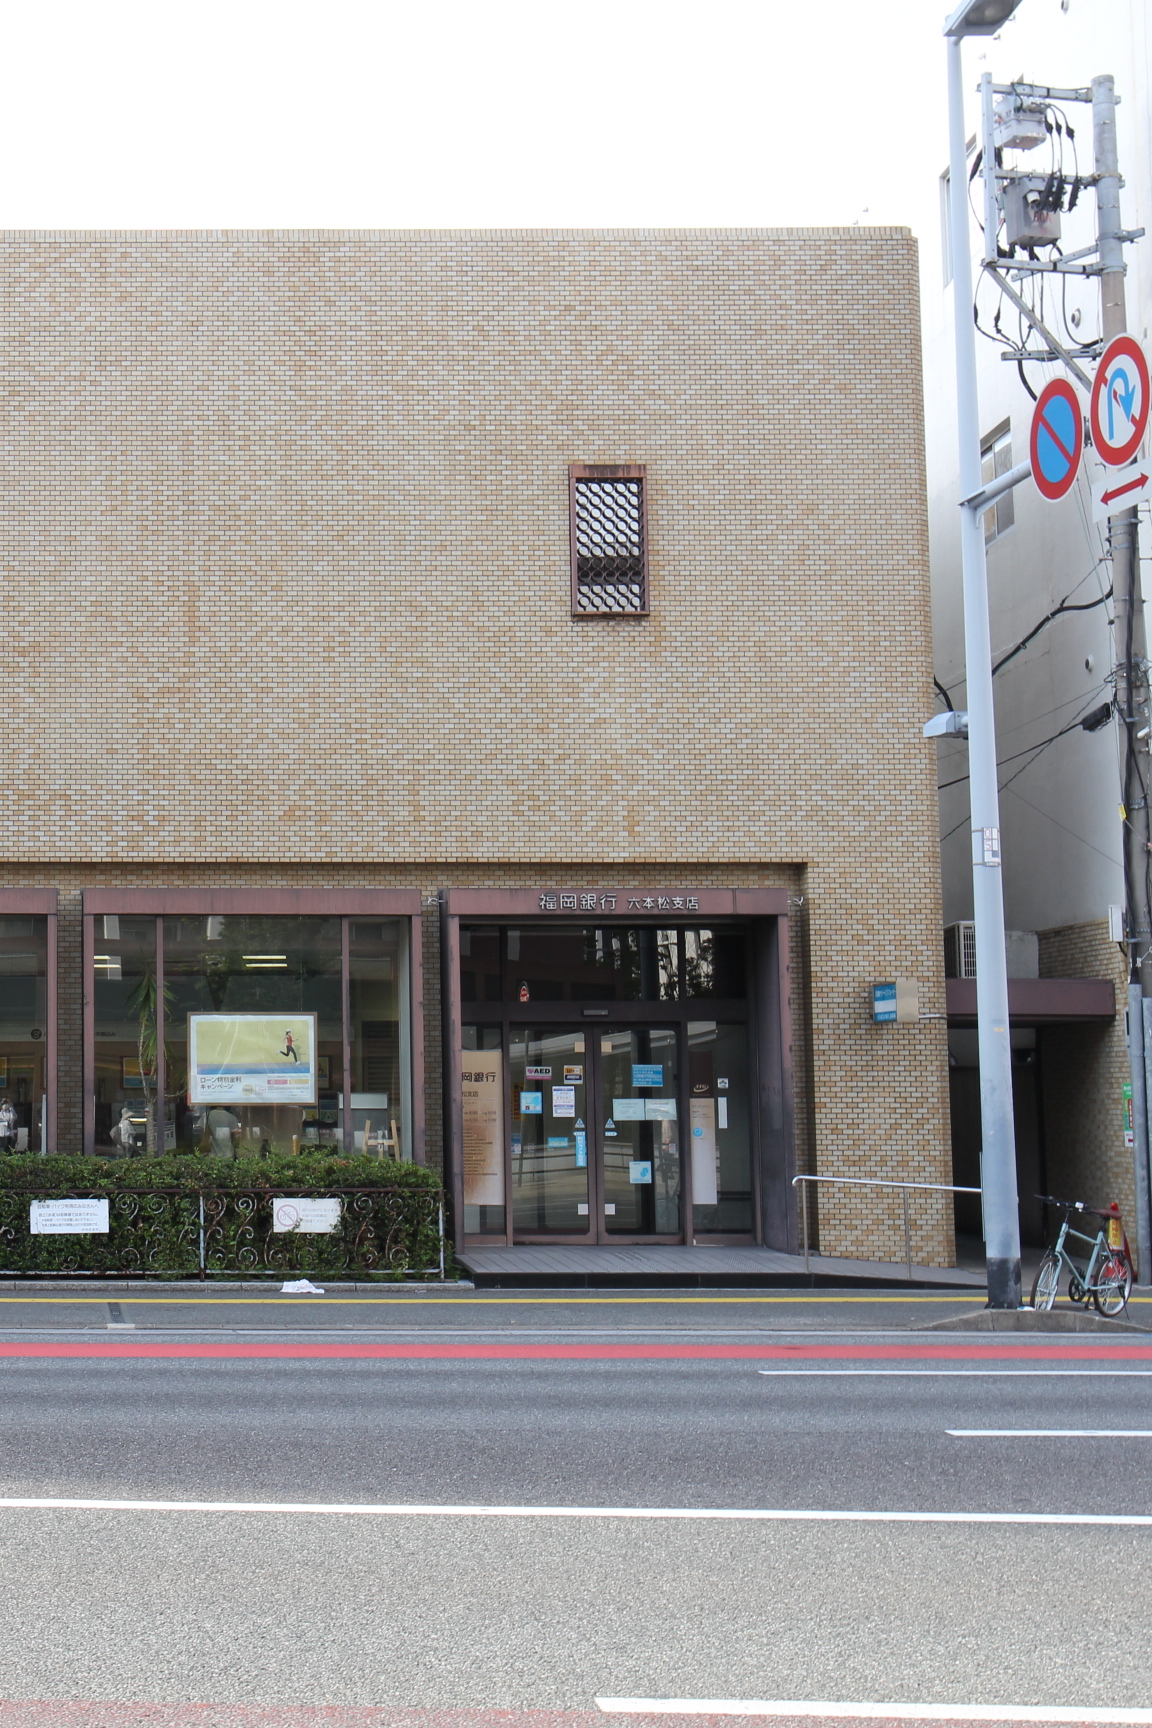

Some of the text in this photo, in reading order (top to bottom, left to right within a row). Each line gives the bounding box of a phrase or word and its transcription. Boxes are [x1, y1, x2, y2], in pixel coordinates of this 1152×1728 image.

[539, 893, 700, 910] 福岡銀行 六本松支店
